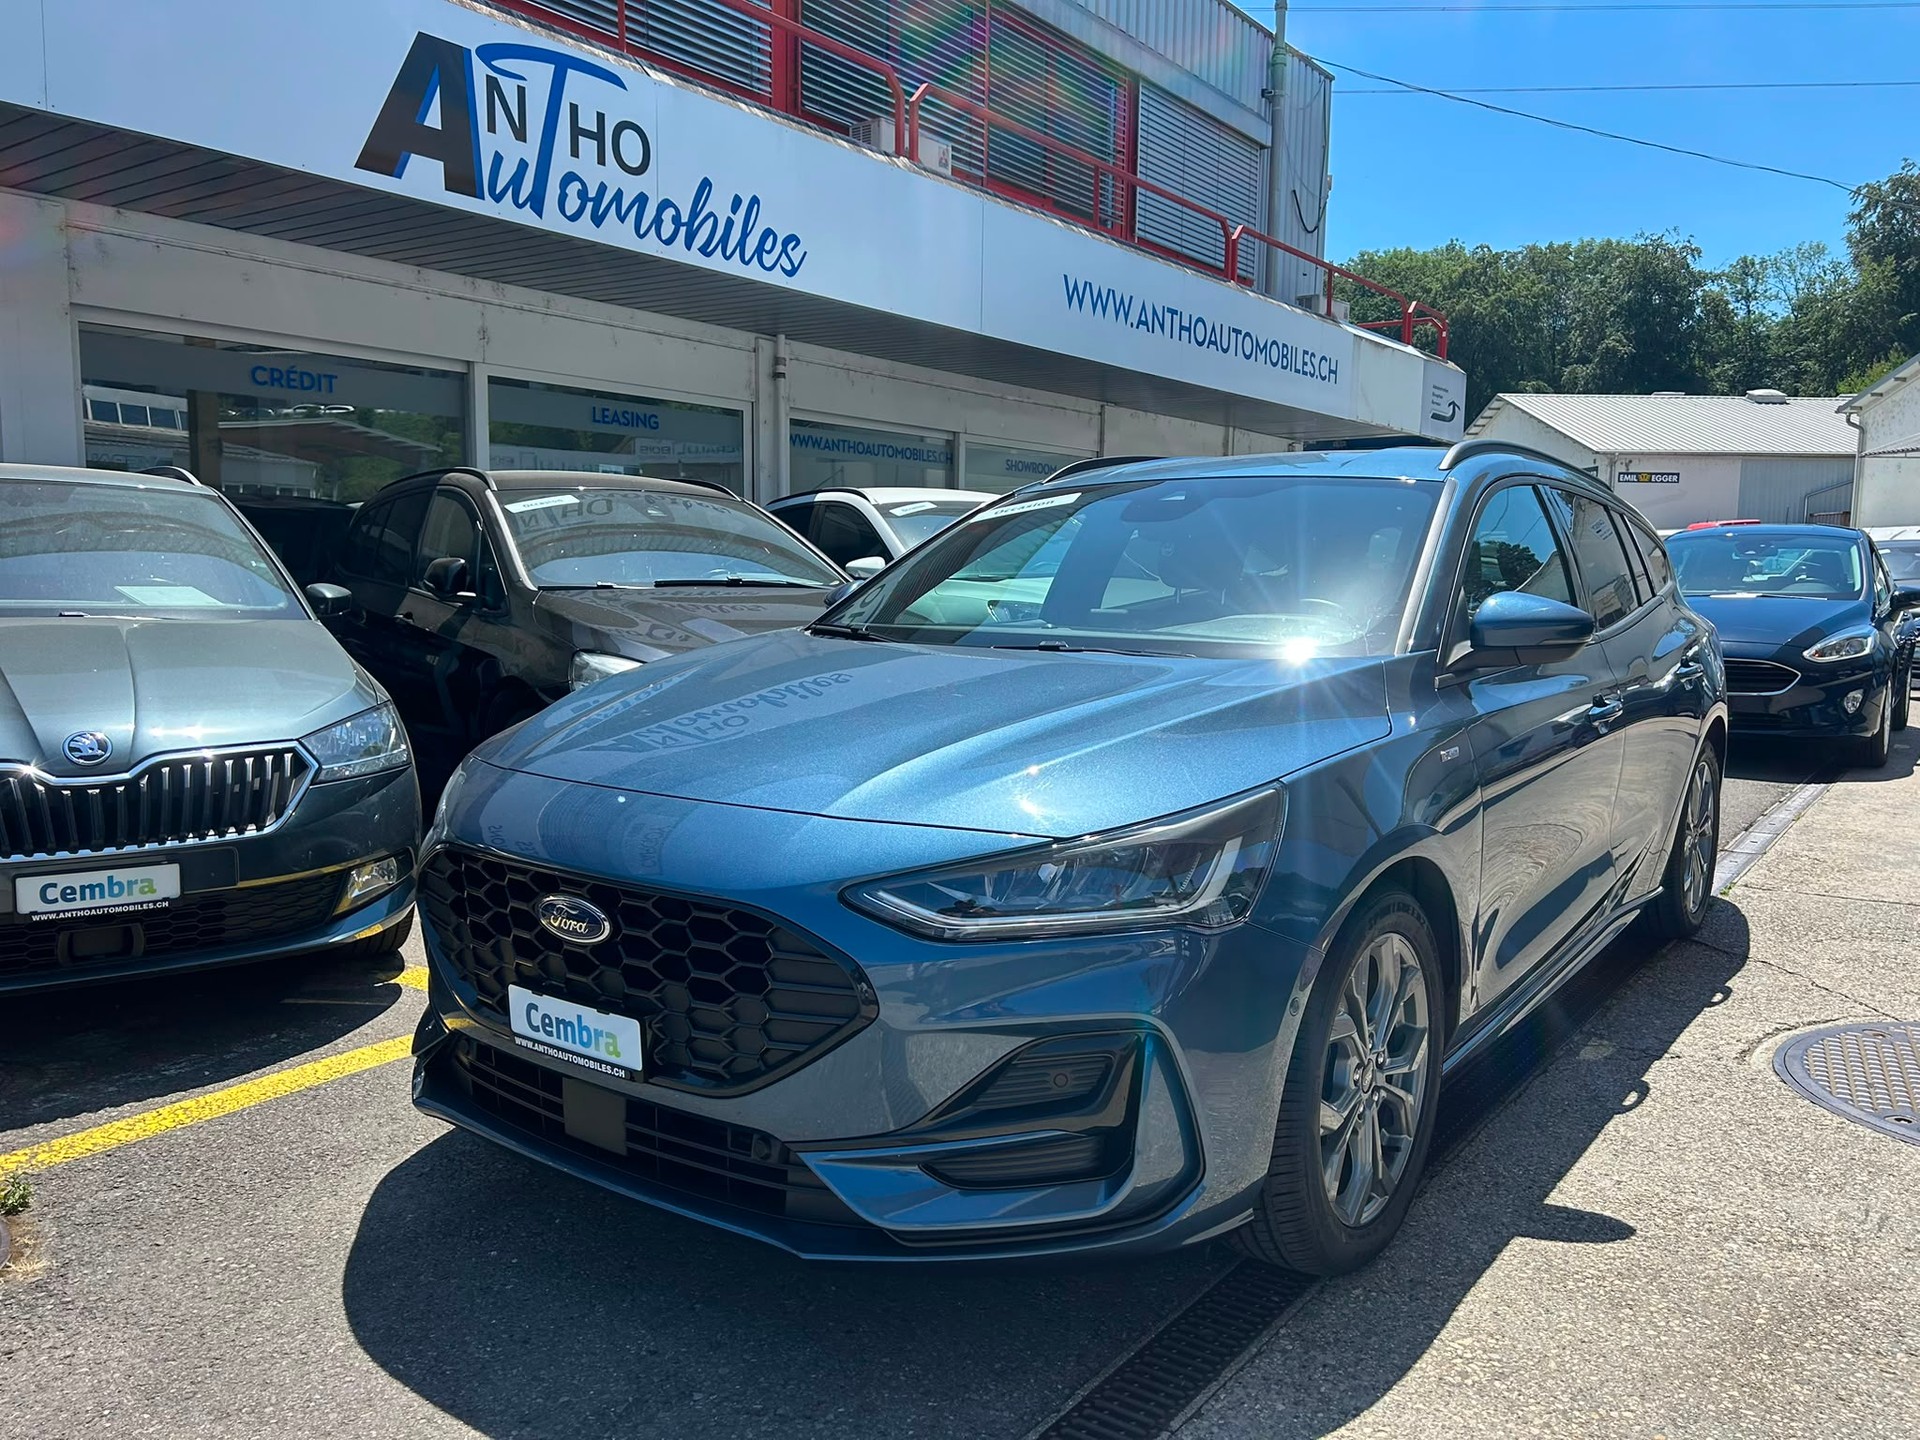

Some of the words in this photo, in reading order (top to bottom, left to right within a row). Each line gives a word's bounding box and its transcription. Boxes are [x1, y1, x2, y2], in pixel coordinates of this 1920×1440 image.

[354, 31, 651, 212] ANTHO
[1063, 274, 1338, 385] WWW.ANTHOAUTOMOBILES.CH
[250, 364, 337, 394] CRÉDIT
[592, 406, 659, 430] LEASING
[1005, 459, 1057, 475] SHOWROOM
[1620, 474, 1638, 482] EMIL
[1651, 474, 1678, 483] EGGER
[39, 875, 157, 905] Cembra
[32, 901, 169, 922] WWW.ANTHOAUTOMOBILES.CH
[526, 1002, 621, 1058] Cembra
[515, 1037, 625, 1078] WWW.ANTHOAUTOMOBILES.CH
